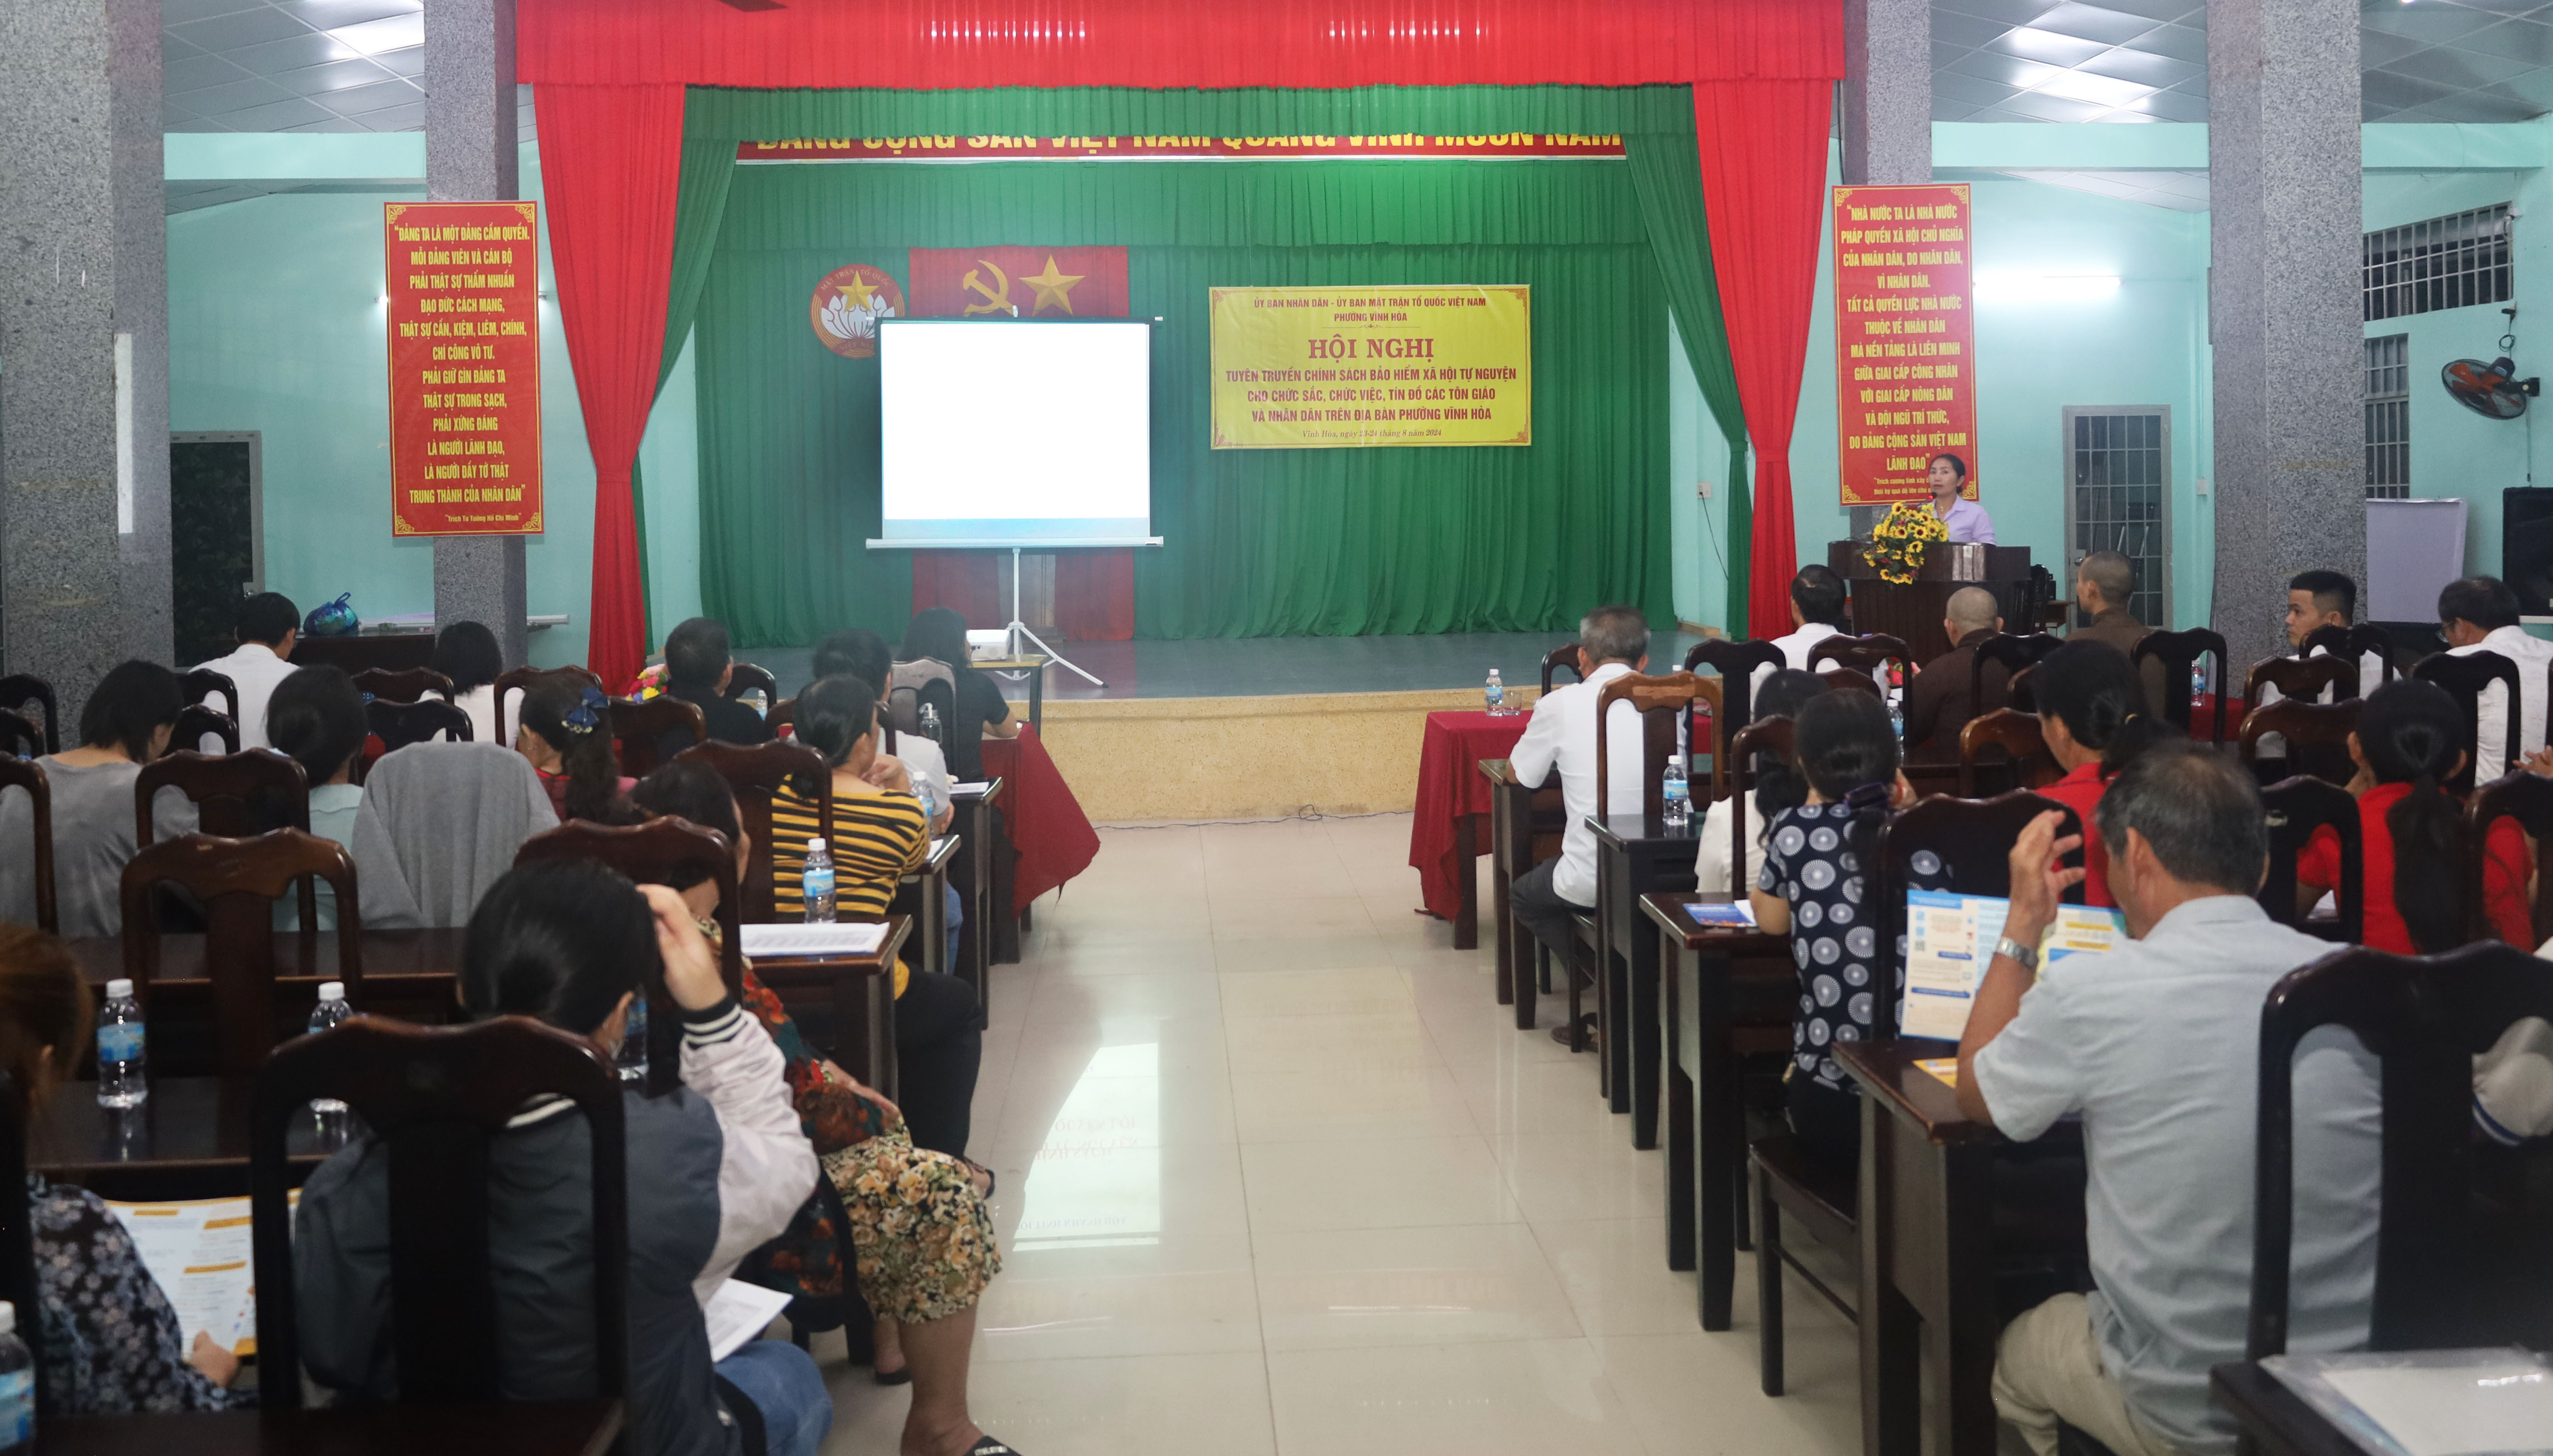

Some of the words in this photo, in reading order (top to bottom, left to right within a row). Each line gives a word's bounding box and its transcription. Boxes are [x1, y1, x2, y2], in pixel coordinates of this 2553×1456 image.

[1870, 204, 1892, 221] NƯỚC
[1894, 207, 1903, 220] TA
[1905, 204, 1915, 220] LÀ
[1917, 203, 1933, 219] NHÀ
[1935, 202, 1957, 219] NƯỚC
[411, 246, 426, 265] MỖI
[428, 247, 449, 264] ĐẢNG
[452, 248, 469, 264] VIÊN
[472, 249, 482, 264] VÀ
[483, 248, 499, 264] CÁN
[502, 247, 512, 267] BỘ
[1843, 249, 1859, 266] CỦA
[1862, 250, 1884, 266] NHÂN
[1886, 250, 1905, 267] DÂN,
[1907, 252, 1917, 265] DO
[1920, 249, 1942, 265] NHÂN
[1944, 248, 1963, 266] DÂN,
[421, 299, 436, 316] ĐẠO
[439, 296, 453, 312] ĐỨC
[457, 296, 477, 312] CÁCH
[479, 299, 505, 315] MẠNG,
[1254, 297, 1264, 308] ỦY
[1267, 299, 1284, 307] BAN
[1287, 298, 1310, 307] NHÂN
[1312, 298, 1328, 307] DÂN
[1337, 296, 1346, 307] ỦY
[1350, 299, 1366, 307] BAN
[1369, 298, 1386, 308] MẶT
[1389, 297, 1409, 308] TRẬN
[1413, 295, 1422, 306] TỔ
[1424, 295, 1445, 307] QUỐC
[1448, 297, 1464, 308] VIỆT
[1468, 298, 1486, 306] NAM
[1334, 313, 1367, 321] PHƯỜNG
[1370, 312, 1388, 321] VĨNH
[1391, 311, 1407, 321] HÒA
[399, 320, 419, 339] THẬT
[421, 322, 432, 339] SỰ
[454, 320, 476, 339] KIỆM,
[478, 320, 498, 337] LIÊM,
[501, 319, 527, 336] CHÍNH,
[433, 344, 445, 359] CHÍ
[448, 344, 468, 359] CÔNG
[471, 344, 481, 359] VÔ
[483, 346, 495, 359] TƯ.
[1308, 333, 1357, 363] HỘI
[1367, 338, 1434, 362] NGHỊ
[423, 366, 441, 384] PHẢI
[443, 368, 456, 384] GIỮ
[458, 367, 472, 383] GÌN
[474, 366, 495, 383] ĐẢNG
[497, 369, 506, 383] TA
[1226, 368, 1258, 382] TUYÊN
[1262, 366, 1301, 381] TRUYỀN
[1305, 368, 1336, 381] CHÍNH
[1340, 367, 1366, 381] SÁCH
[1370, 366, 1390, 381] BẢO
[1394, 364, 1419, 380] HIỂM
[1423, 367, 1437, 380] XÃ
[1440, 366, 1456, 382] HỘI
[1460, 368, 1474, 382] TỰ
[1475, 366, 1516, 382] NGUYỆN
[1854, 365, 1873, 380] GIỮA
[1875, 367, 1892, 380] GIAI
[1912, 363, 1933, 379] CÔNG
[1935, 362, 1958, 378] NHÂN
[423, 392, 442, 411] THẬT
[444, 393, 455, 410] SỰ
[456, 394, 482, 407] TRONG
[484, 394, 507, 409] SẠCH,
[1248, 390, 1268, 402] CHO
[1272, 388, 1299, 402] CHỨC
[1302, 386, 1326, 403] SẮC,
[1329, 388, 1356, 401] CHỨC
[1360, 388, 1385, 403] VIỆC,
[1389, 388, 1405, 400] TÍN
[1409, 385, 1422, 400] ĐỒ
[1426, 387, 1445, 400] CÁC
[1449, 387, 1468, 400] TÔN
[1472, 386, 1495, 399] GIÁO
[1861, 387, 1873, 403] VỚI
[1876, 390, 1892, 403] GIAI
[1912, 386, 1935, 402] NÔNG
[1937, 385, 1953, 401] DÂN
[433, 413, 451, 431] PHẢI
[454, 415, 475, 431] XỨNG
[477, 415, 498, 430] ĐÁNG
[1252, 408, 1265, 422] VÀ
[1268, 408, 1297, 422] NHÂN
[1301, 408, 1322, 421] DÂN
[1325, 408, 1351, 421] TRÊN
[1354, 410, 1371, 423] ĐỊA
[1375, 407, 1395, 421] BÀN
[1400, 407, 1441, 420] PHƯỜNG
[1444, 407, 1468, 419] VĨNH
[1471, 405, 1492, 419] HÒA
[1866, 410, 1876, 426] VÀ
[1878, 409, 1892, 428] ĐỘI
[1893, 409, 1910, 425] NGŨ
[1912, 408, 1925, 424] TRÍ
[1927, 408, 1949, 424] THỨC,
[1380, 429, 1400, 438] tháng
[1849, 436, 1860, 449] DO
[1862, 431, 1884, 448] ĐẢNG
[1887, 432, 1908, 450] CỘNG
[1911, 430, 1927, 447] SẢN
[1929, 431, 1945, 449] VIỆT
[1948, 433, 1966, 446] NAM
[428, 439, 437, 456] LÀ
[439, 438, 463, 455] NGƯỜI
[465, 439, 485, 455] LÃNH
[487, 441, 505, 457] ĐẠO,
[1887, 455, 1907, 471] LÃNH
[409, 490, 434, 503] TRUNG
[437, 486, 462, 502] THÀNH
[464, 484, 480, 502] CỦA
[482, 486, 503, 502] NHÂN
